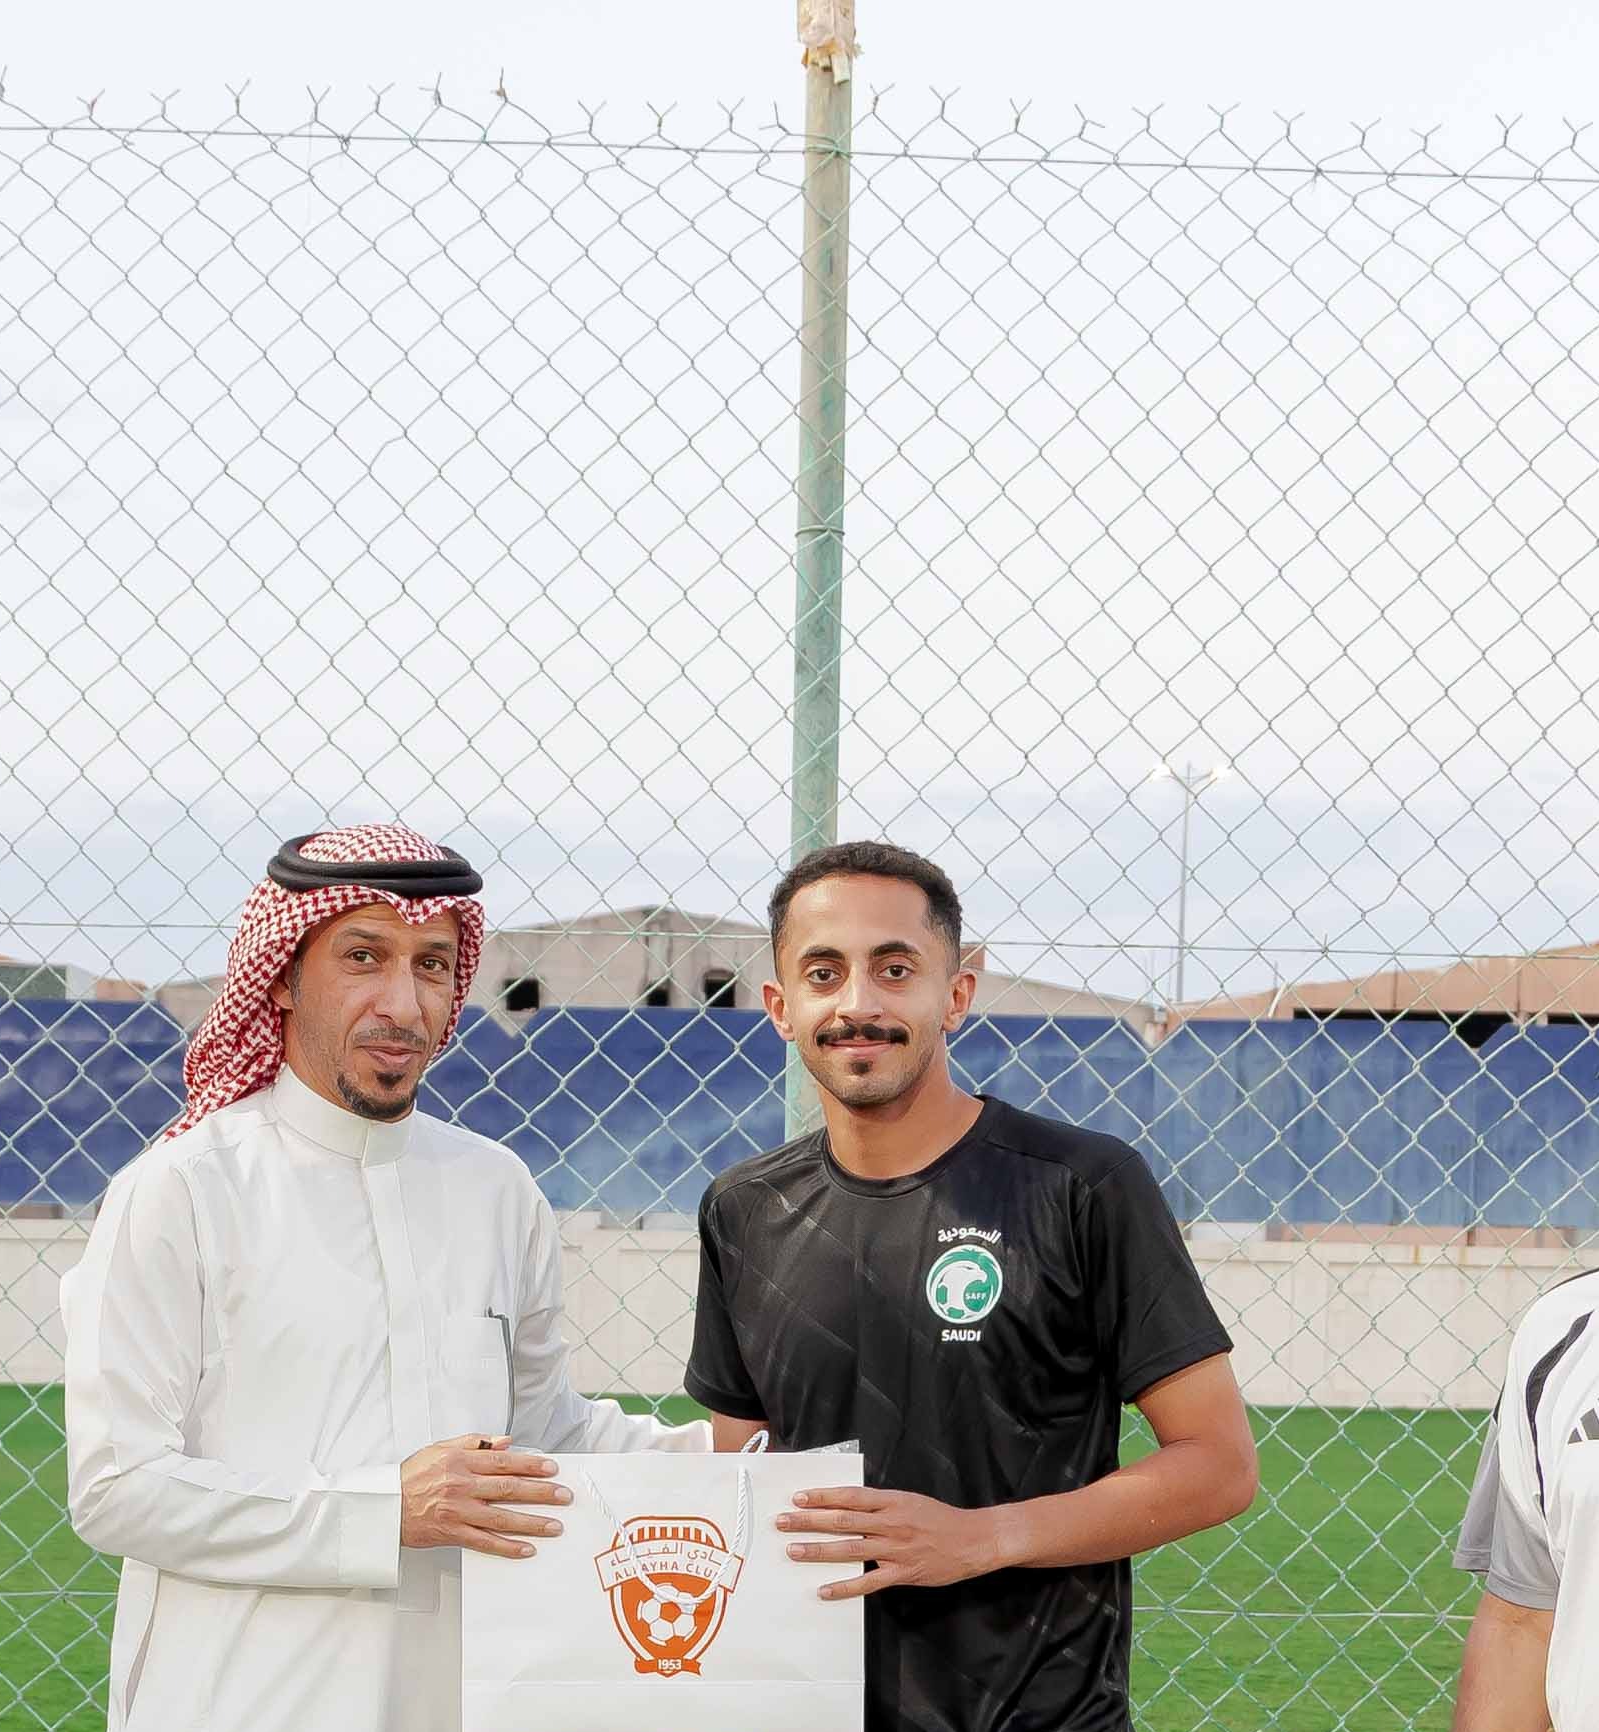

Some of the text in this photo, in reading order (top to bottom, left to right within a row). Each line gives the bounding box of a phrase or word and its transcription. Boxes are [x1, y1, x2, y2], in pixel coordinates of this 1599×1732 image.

[937, 1226, 1002, 1244] السعودية
[941, 1329, 982, 1342] SAUDI
[614, 1560, 680, 1582] ALAYHA
[657, 1658, 682, 1670] 1953
